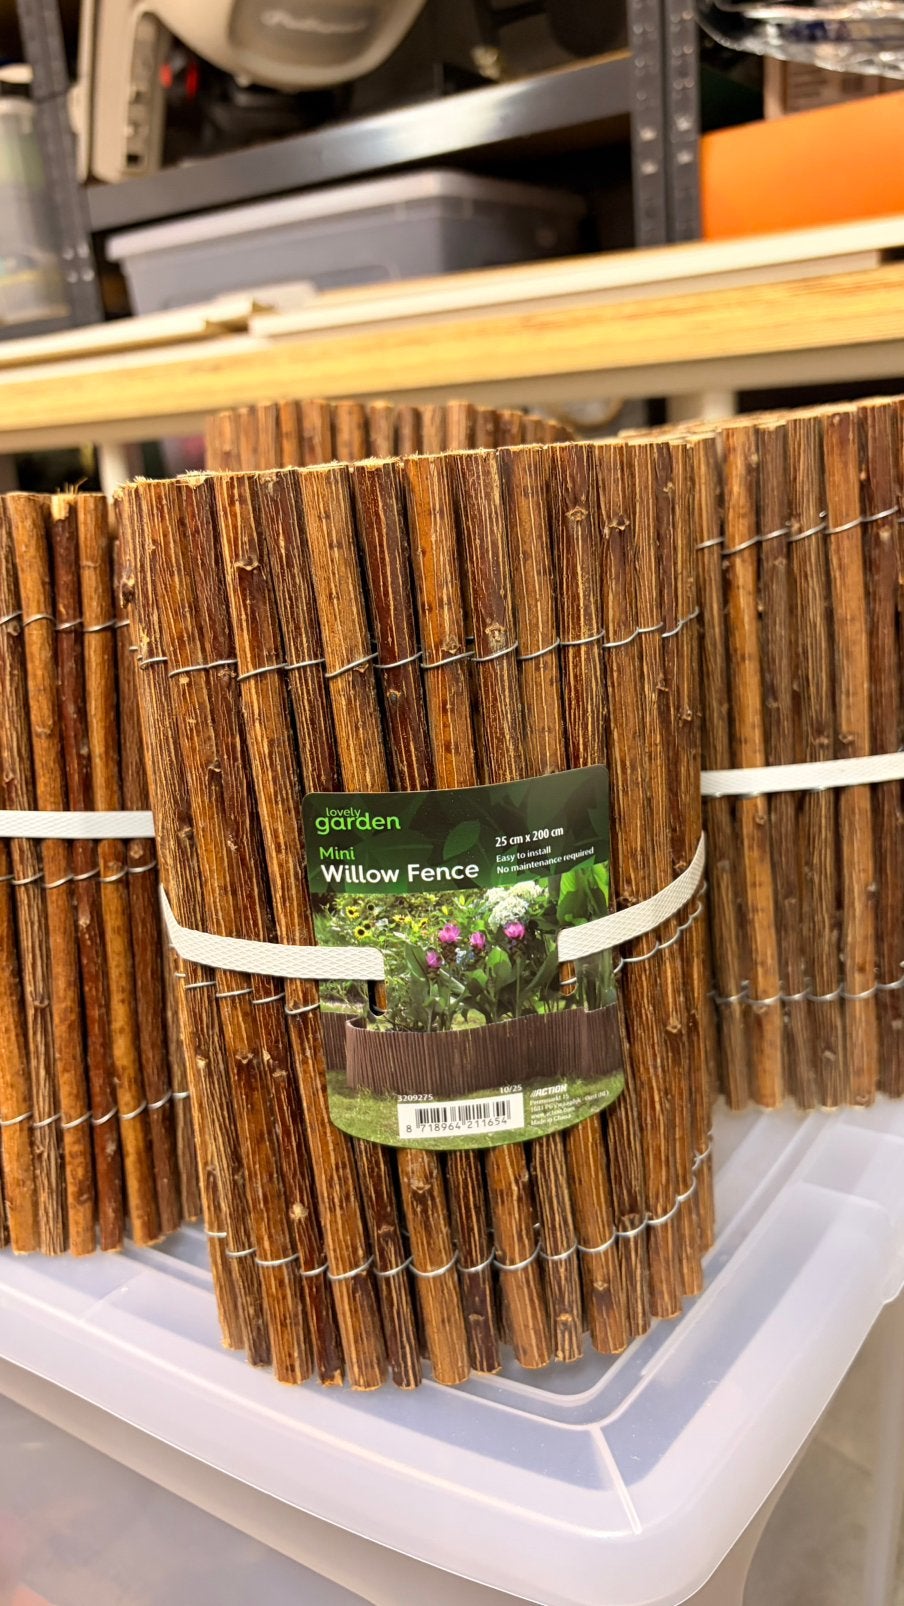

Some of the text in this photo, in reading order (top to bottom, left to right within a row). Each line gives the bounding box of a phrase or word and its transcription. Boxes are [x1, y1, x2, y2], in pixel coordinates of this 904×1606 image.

[326, 807, 361, 819] lovely
[315, 813, 401, 834] garden
[495, 826, 564, 848] 25 cm x 200 cm
[319, 846, 355, 860] Mini
[496, 846, 551, 864] Easy to install
[497, 846, 594, 874] No maintenance required
[321, 863, 480, 884] Willow Fence
[500, 1084, 523, 1094] 10/25
[534, 1085, 568, 1097] ACTION
[398, 1094, 433, 1102] 3209275
[406, 1117, 508, 1133] 8 718964 211654
